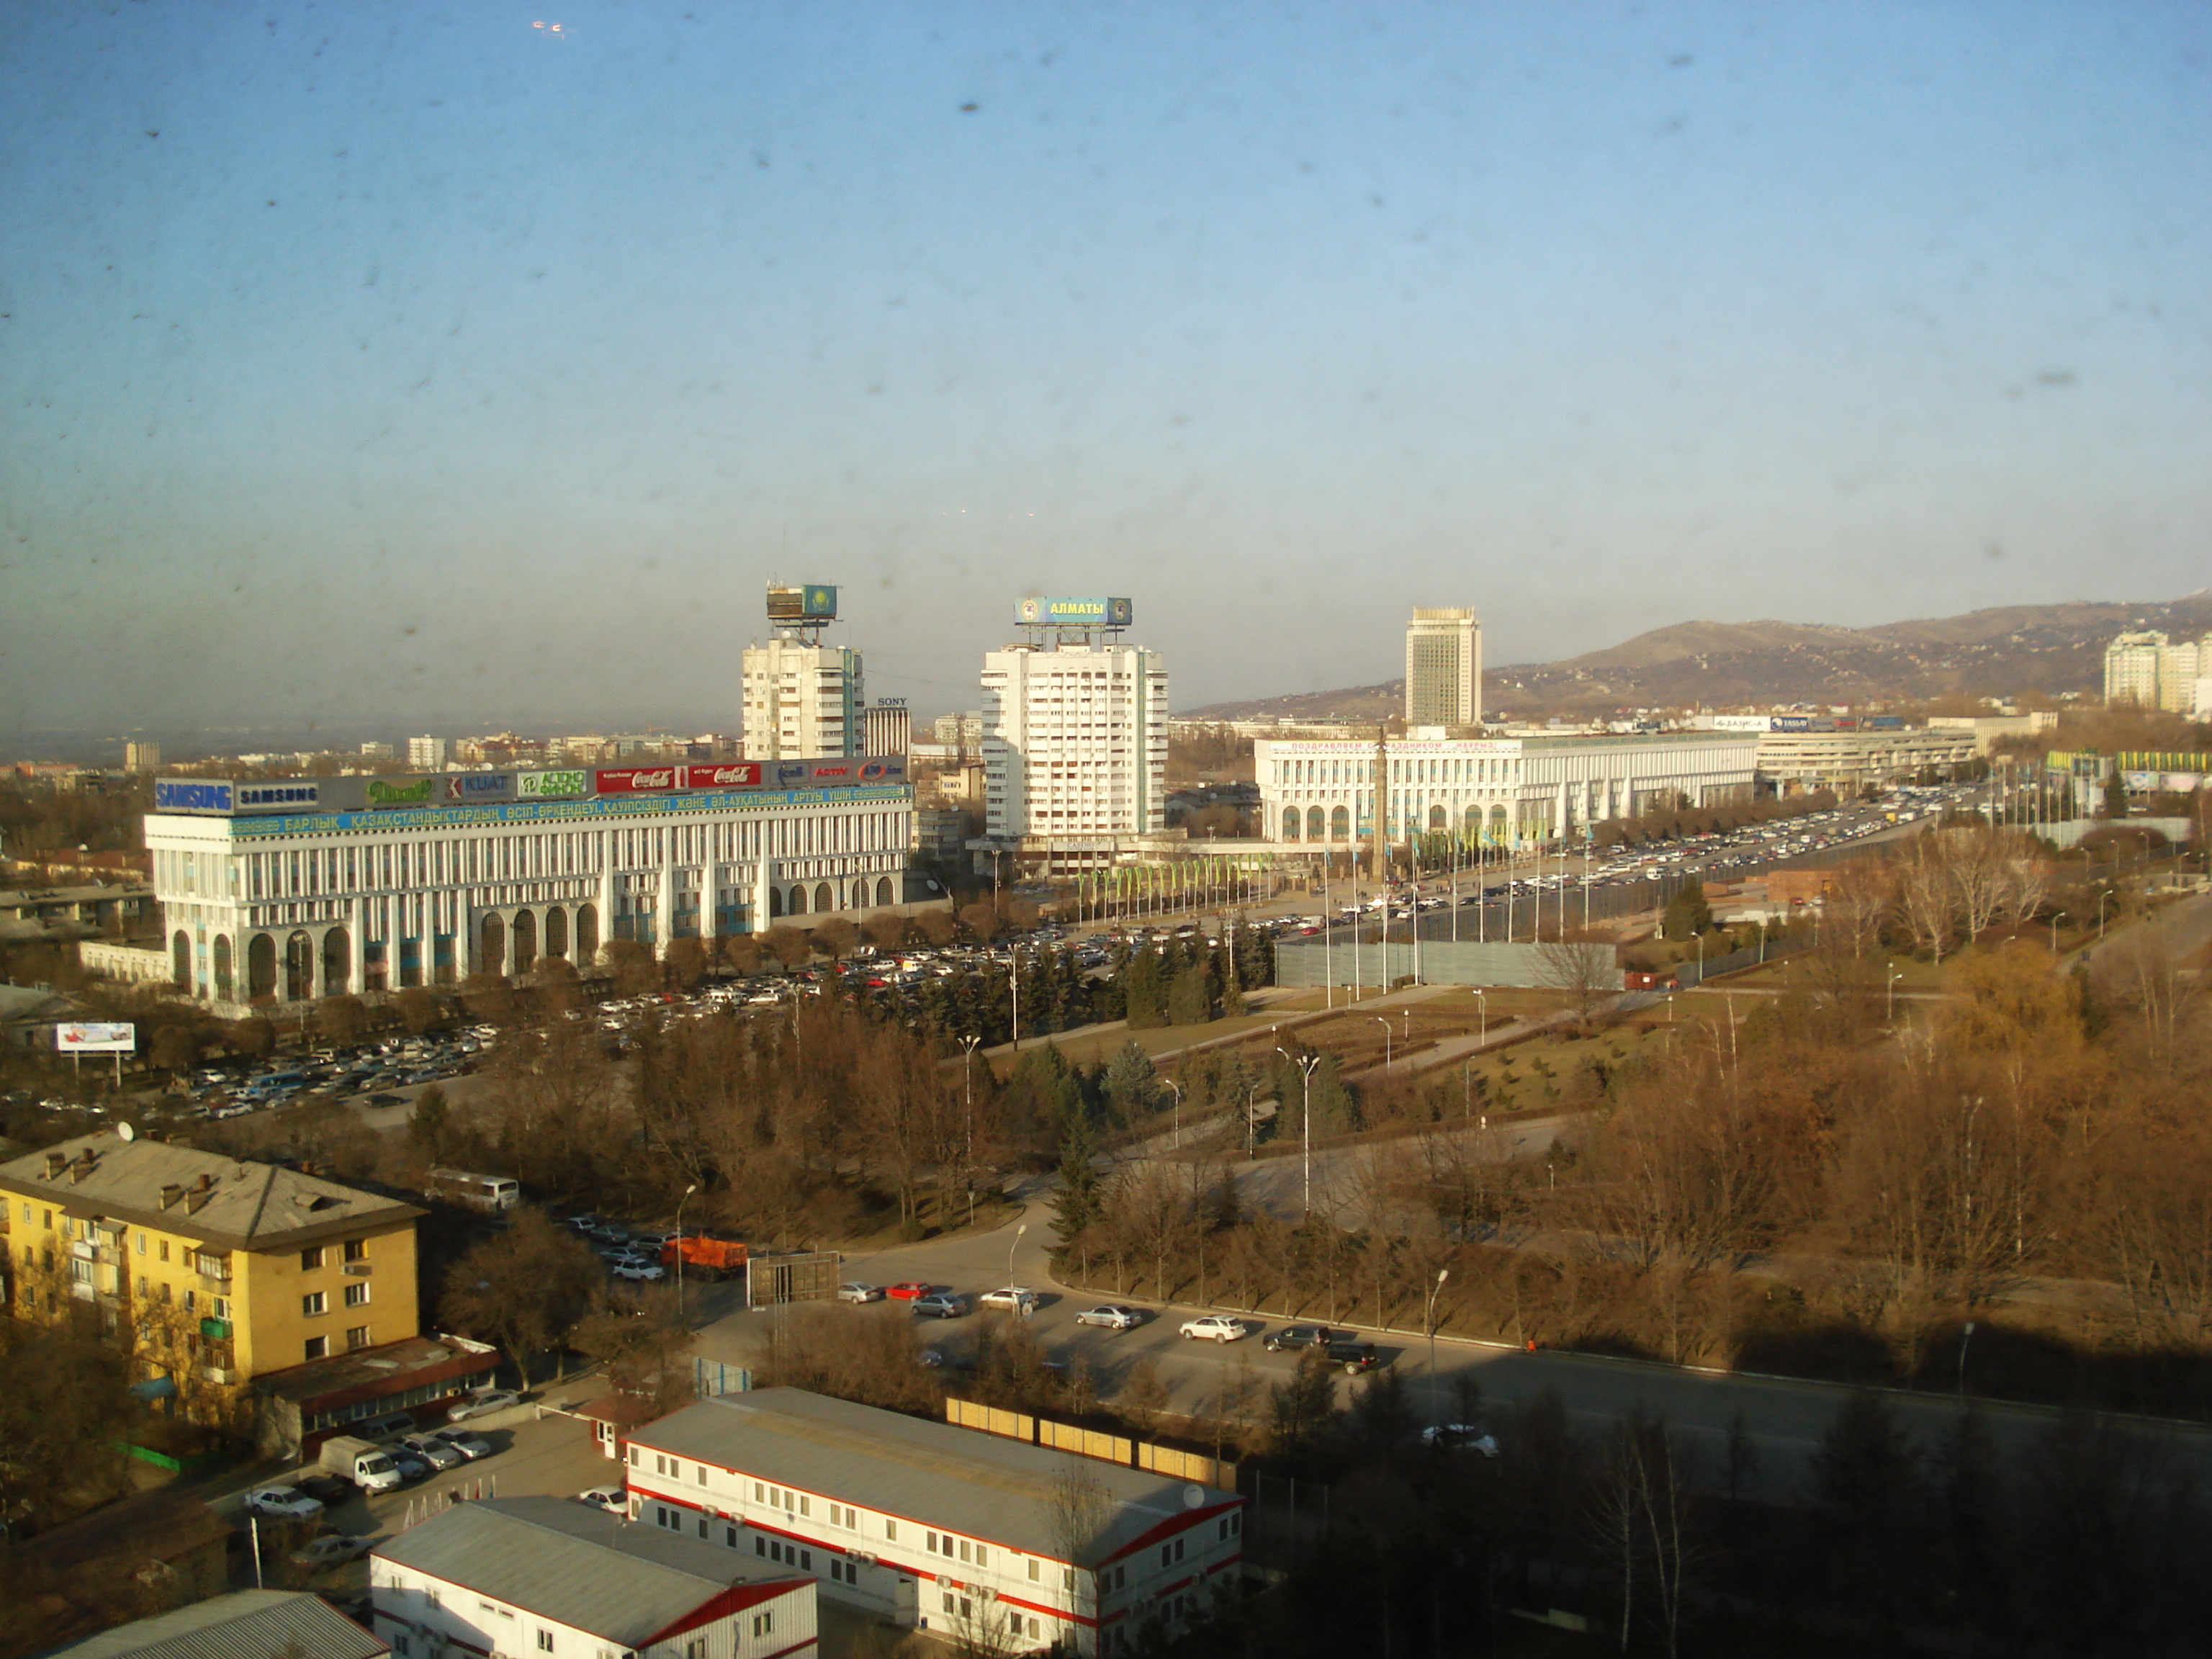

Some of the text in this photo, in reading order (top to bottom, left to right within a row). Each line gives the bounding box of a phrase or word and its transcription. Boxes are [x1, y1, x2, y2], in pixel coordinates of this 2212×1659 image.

[1050, 603, 1103, 614] АЛМАТЫ
[464, 775, 511, 791] KUAT
[156, 783, 231, 810] SAMSUNG
[241, 788, 318, 804] SAMSUNG
[284, 817, 340, 831] БАРЛЫҚ
[676, 796, 706, 809] ЖӘНЕ
[793, 791, 824, 803] АРТУЫ
